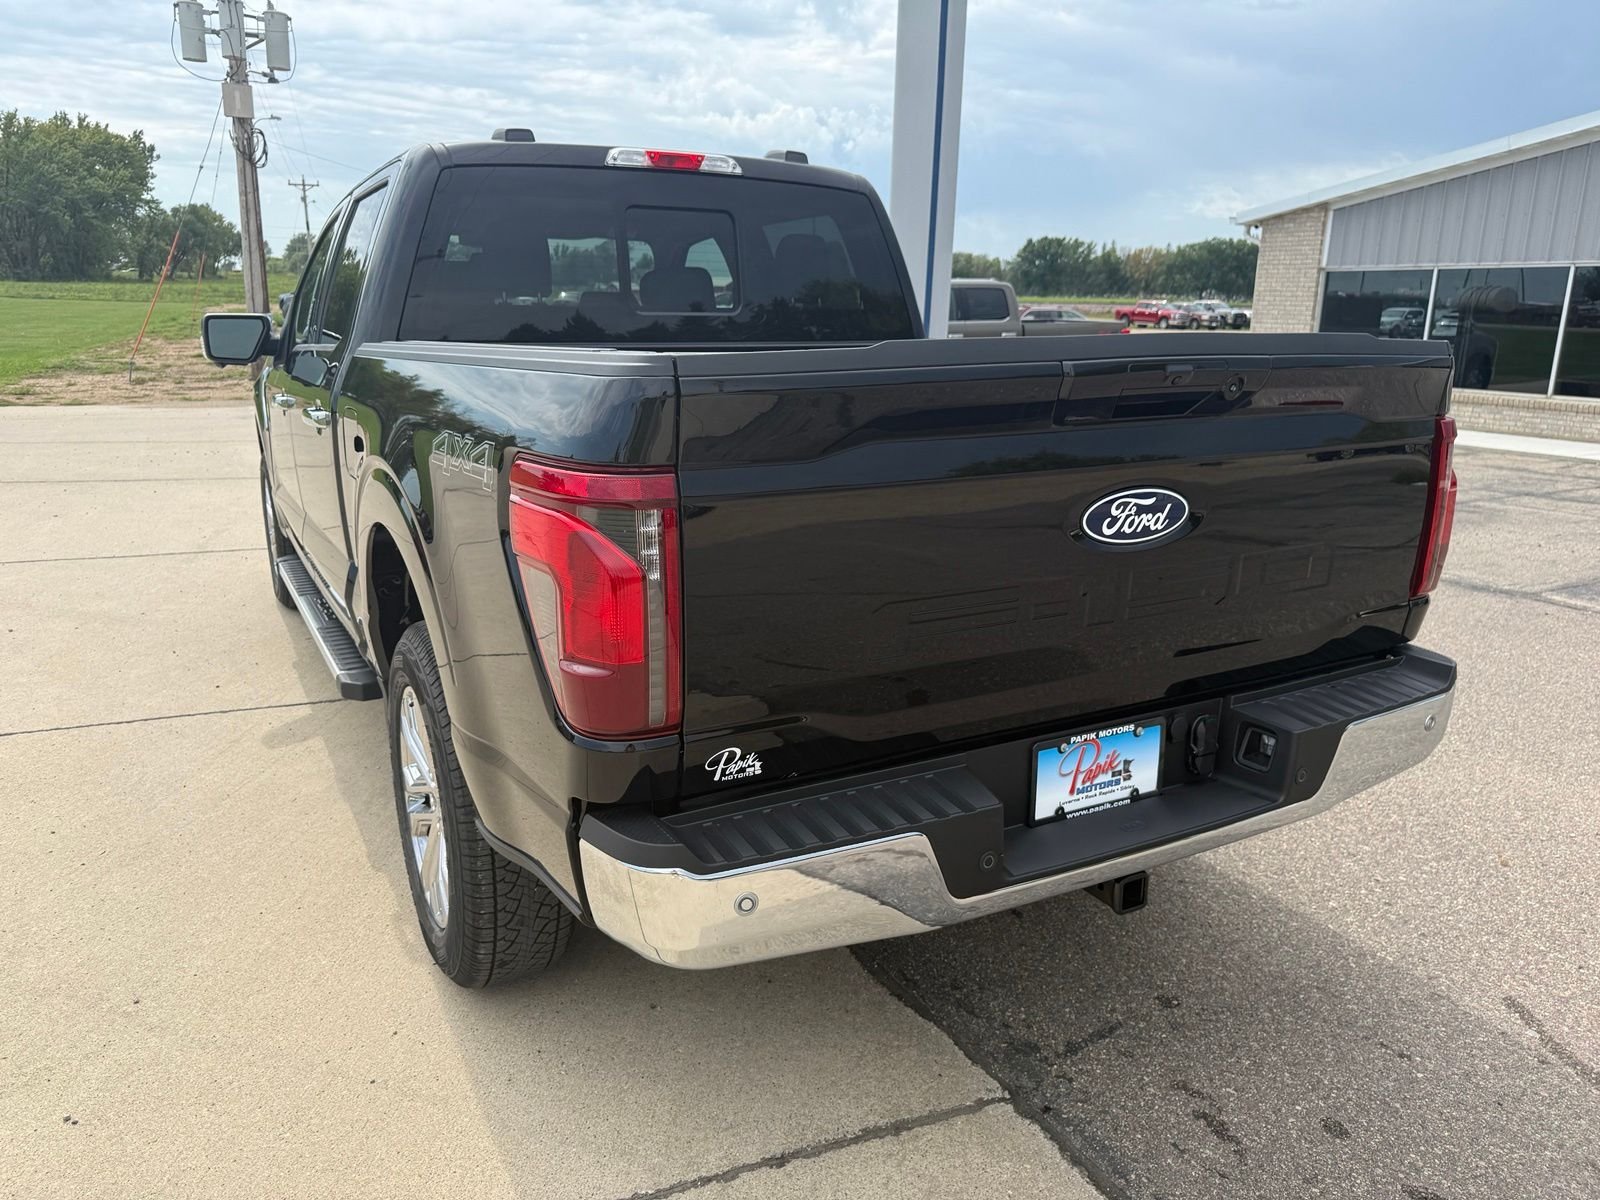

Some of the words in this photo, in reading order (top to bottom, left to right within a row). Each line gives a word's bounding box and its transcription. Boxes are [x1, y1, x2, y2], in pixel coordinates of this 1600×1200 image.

[1102, 496, 1172, 536] Ford
[1070, 732, 1097, 744] PAPIK
[1098, 724, 1135, 738] MOTORS
[705, 747, 759, 781] Papik
[1059, 739, 1120, 796] Papik
[721, 771, 754, 781] MOTORS
[1076, 778, 1121, 795] MOTORS
[1066, 800, 1131, 819] www.papik.com
